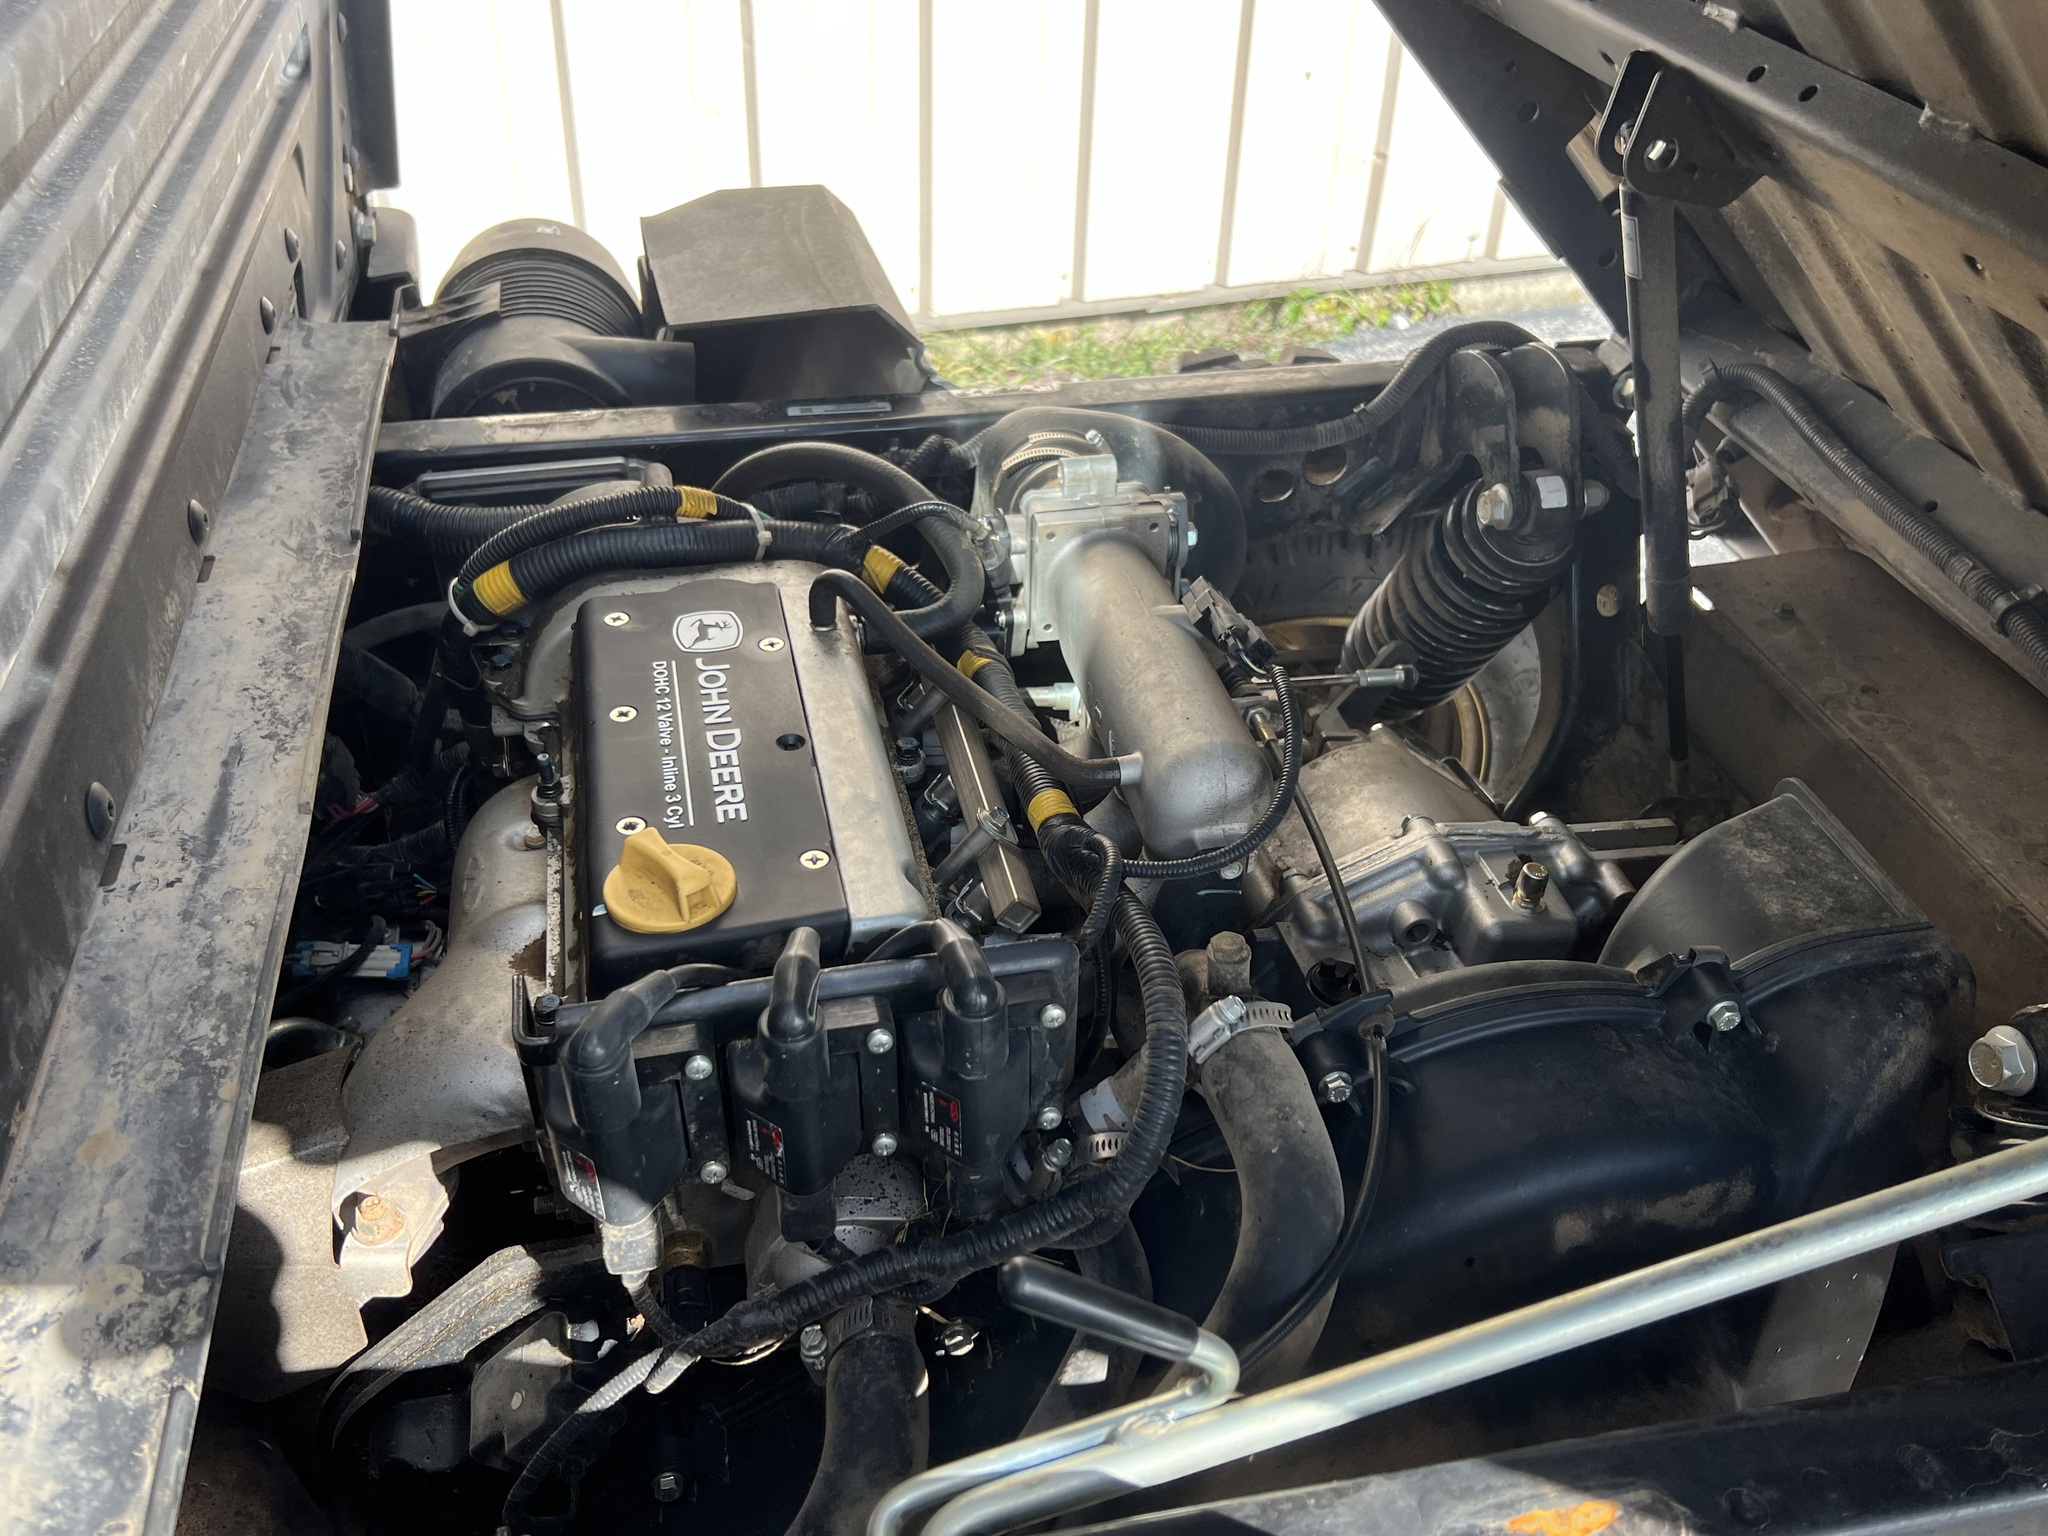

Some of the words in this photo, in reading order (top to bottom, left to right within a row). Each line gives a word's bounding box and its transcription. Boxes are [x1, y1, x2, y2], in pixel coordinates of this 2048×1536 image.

[652, 661, 671, 695] DOHC
[695, 658, 732, 725] JOHN
[655, 697, 672, 712] 12
[657, 712, 675, 747] Valve
[661, 755, 679, 792] Inline
[706, 728, 748, 823] DEERE
[665, 793, 682, 804] 3
[663, 805, 686, 830] Cyl
